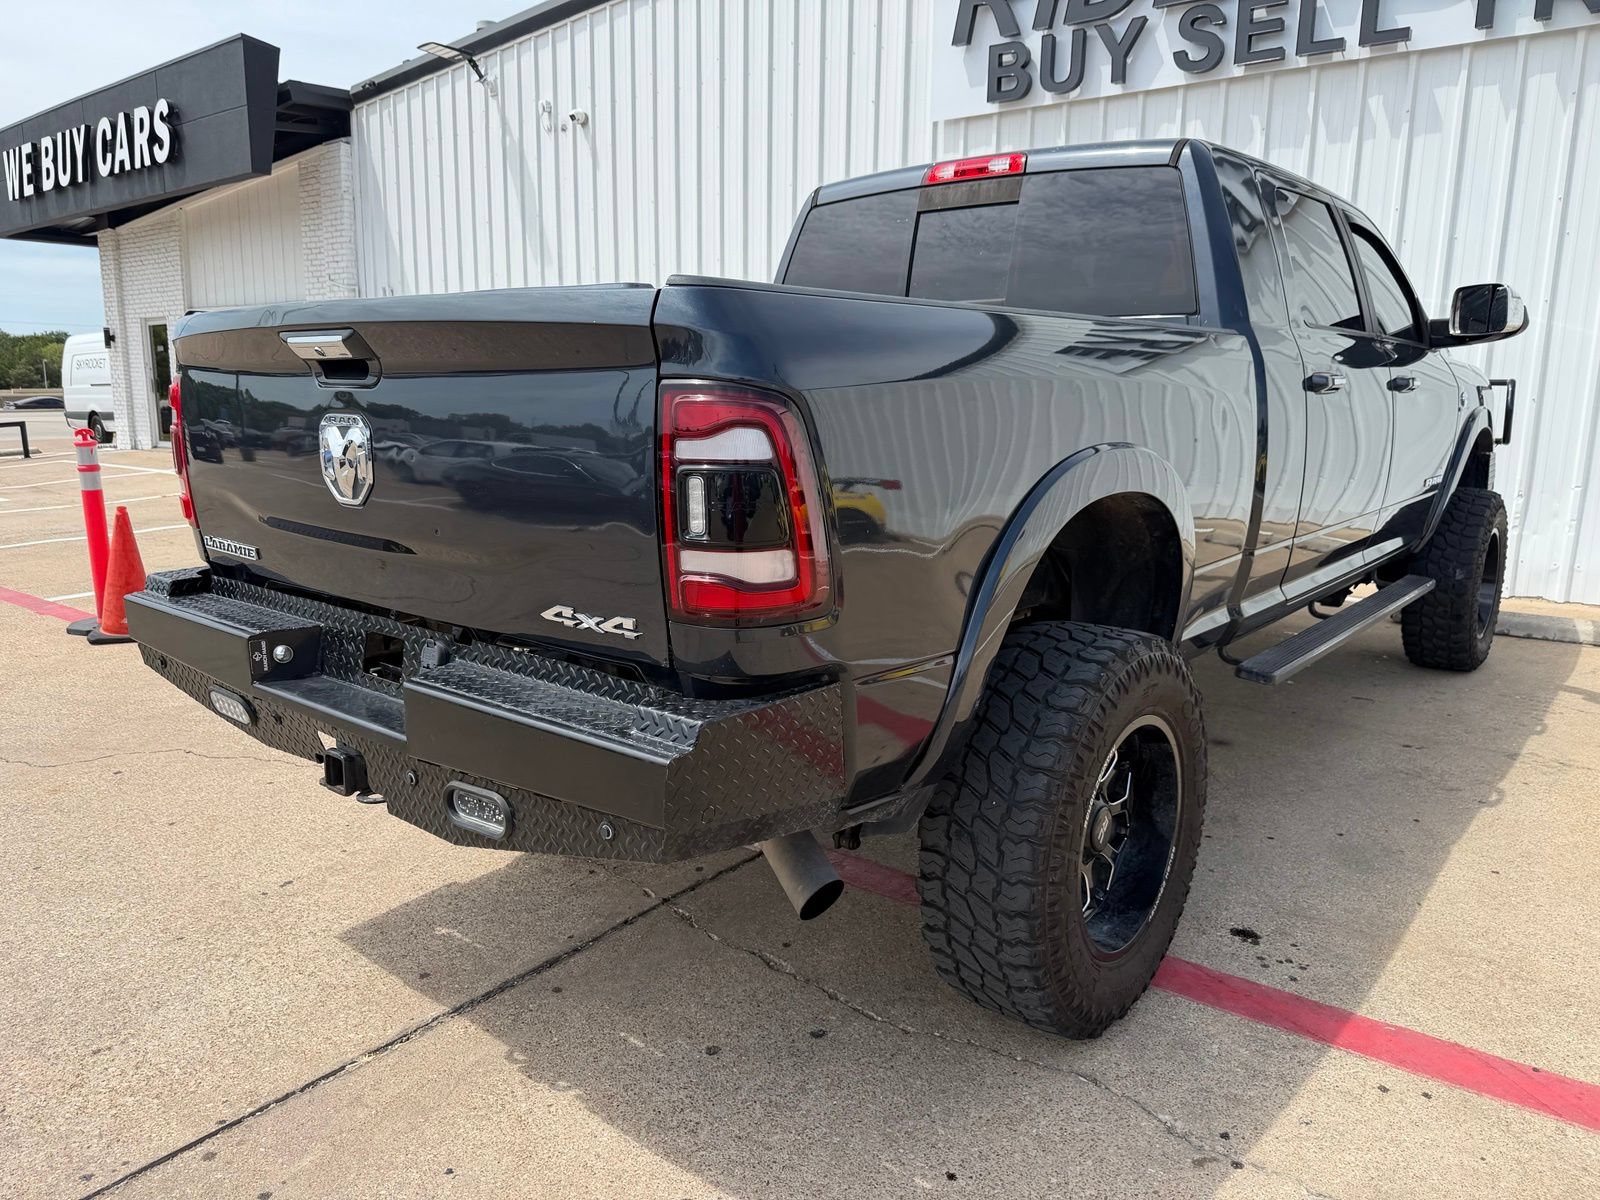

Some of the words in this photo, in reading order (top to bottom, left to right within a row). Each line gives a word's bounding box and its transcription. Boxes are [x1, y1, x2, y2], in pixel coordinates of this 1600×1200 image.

[986, 15, 1149, 103] BUY
[1173, 0, 1412, 73] SELL
[3, 141, 36, 201] WE
[41, 124, 90, 192] BUY
[96, 98, 173, 178] CARS
[328, 416, 360, 425] RAM
[205, 536, 256, 559] LARAMIE
